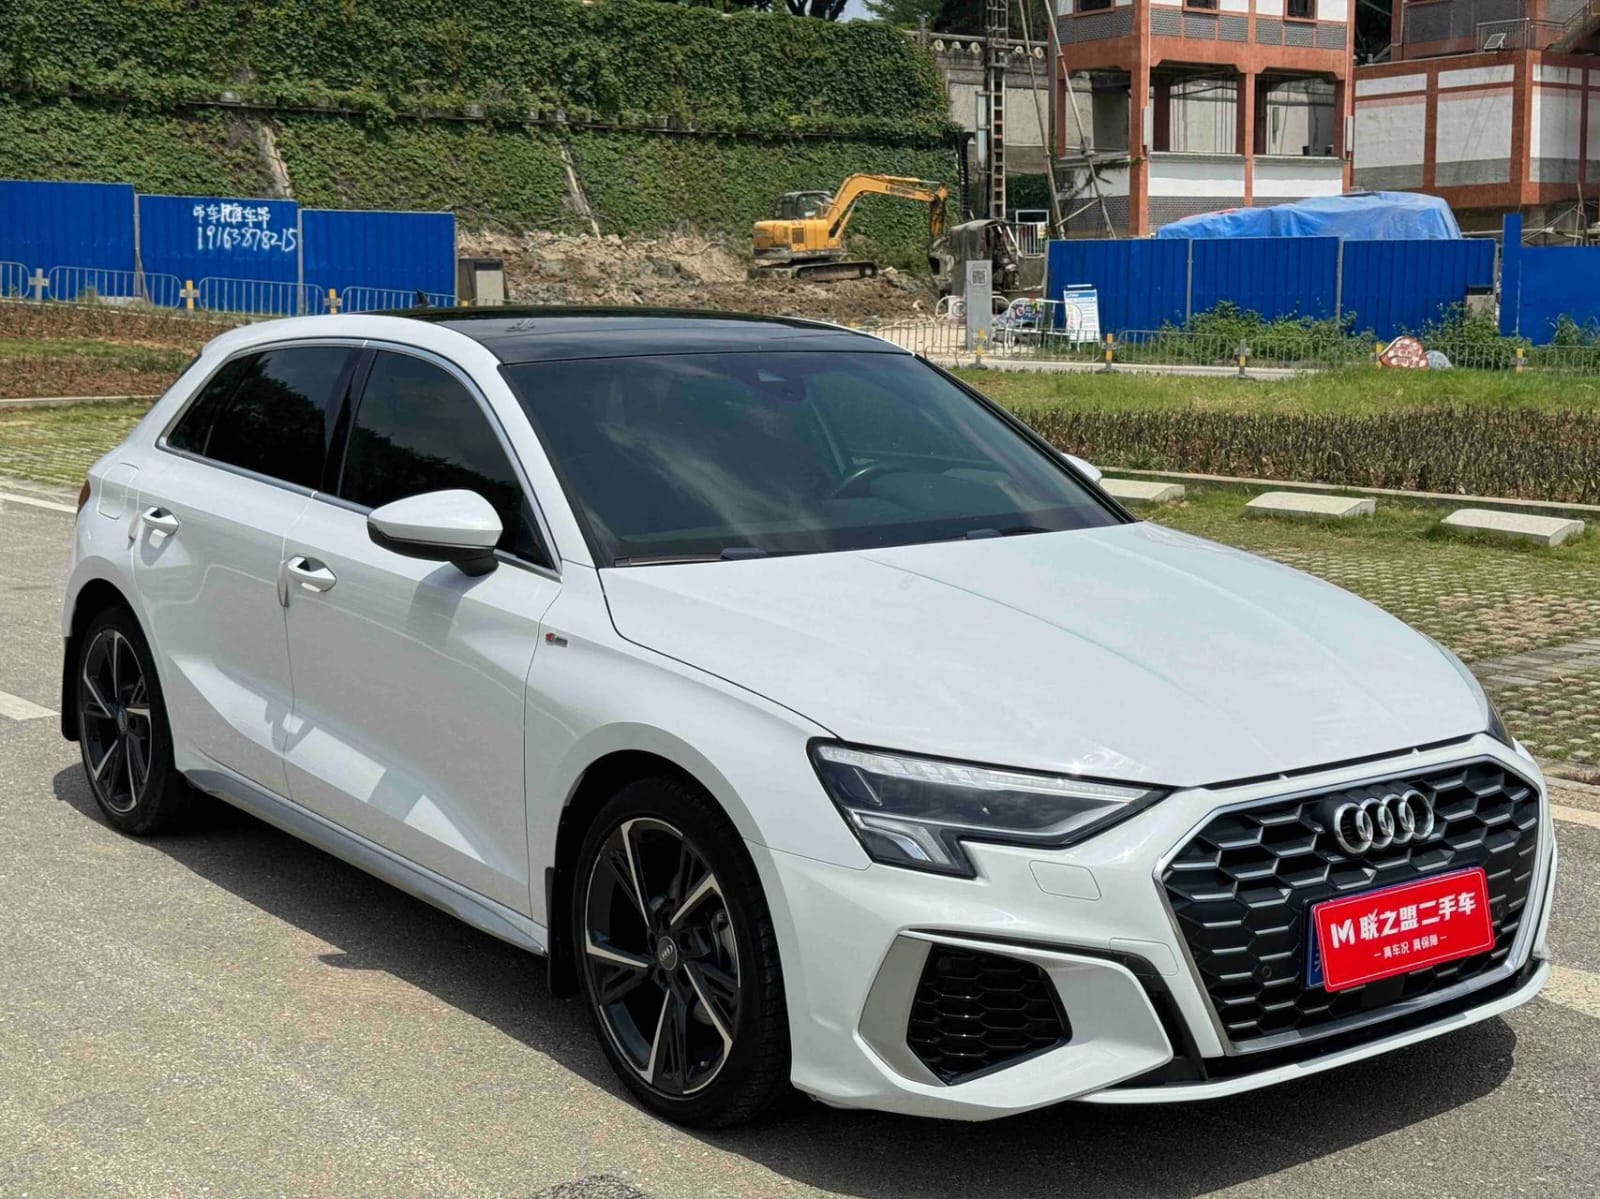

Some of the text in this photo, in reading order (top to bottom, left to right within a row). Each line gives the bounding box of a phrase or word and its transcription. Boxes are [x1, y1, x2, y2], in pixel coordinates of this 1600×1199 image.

[197, 225, 297, 252] 19163878215
[1359, 891, 1477, 941] 联之盟二手车
[1383, 941, 1410, 959] 真车况
